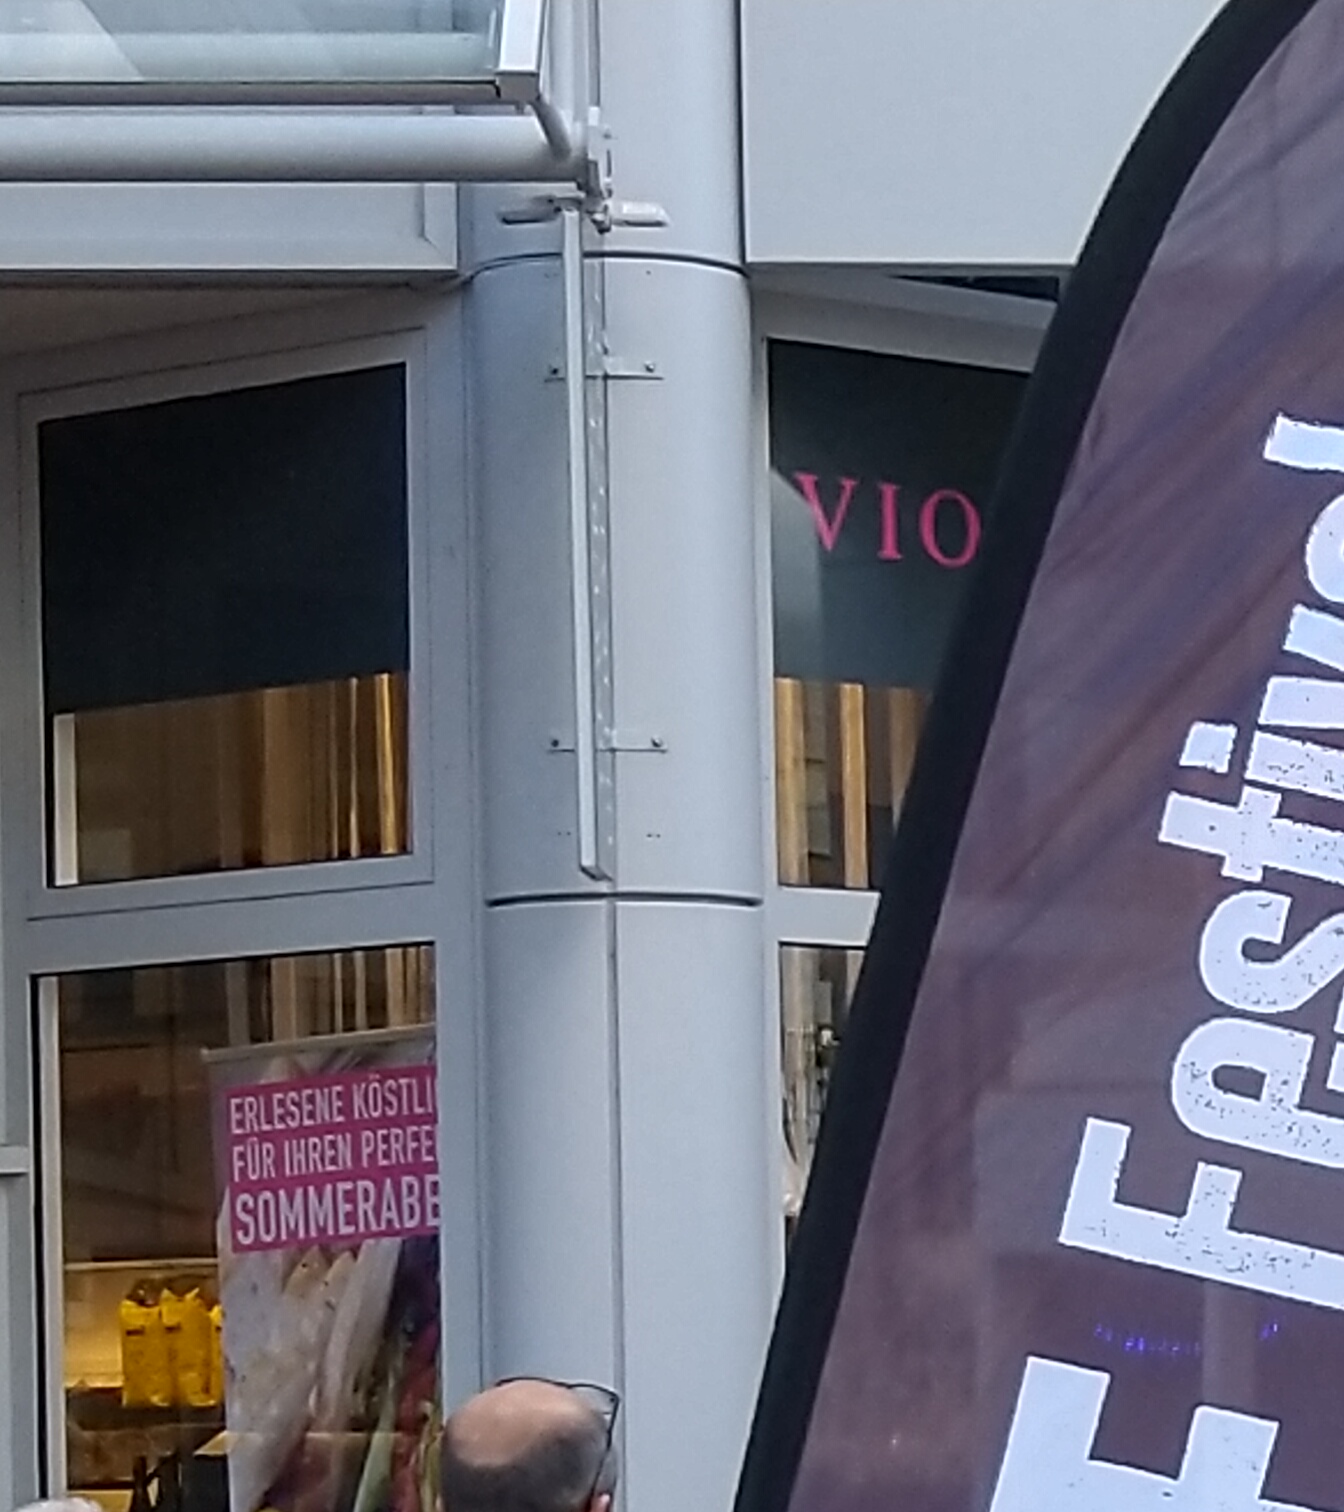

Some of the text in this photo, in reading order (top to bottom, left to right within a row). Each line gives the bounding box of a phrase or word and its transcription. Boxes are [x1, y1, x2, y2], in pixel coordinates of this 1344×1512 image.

[794, 470, 983, 569] VIO
[230, 1074, 434, 1135] ERLESENE KÖSTLI
[232, 1137, 276, 1183] FÜR
[284, 1132, 352, 1178] IHREN
